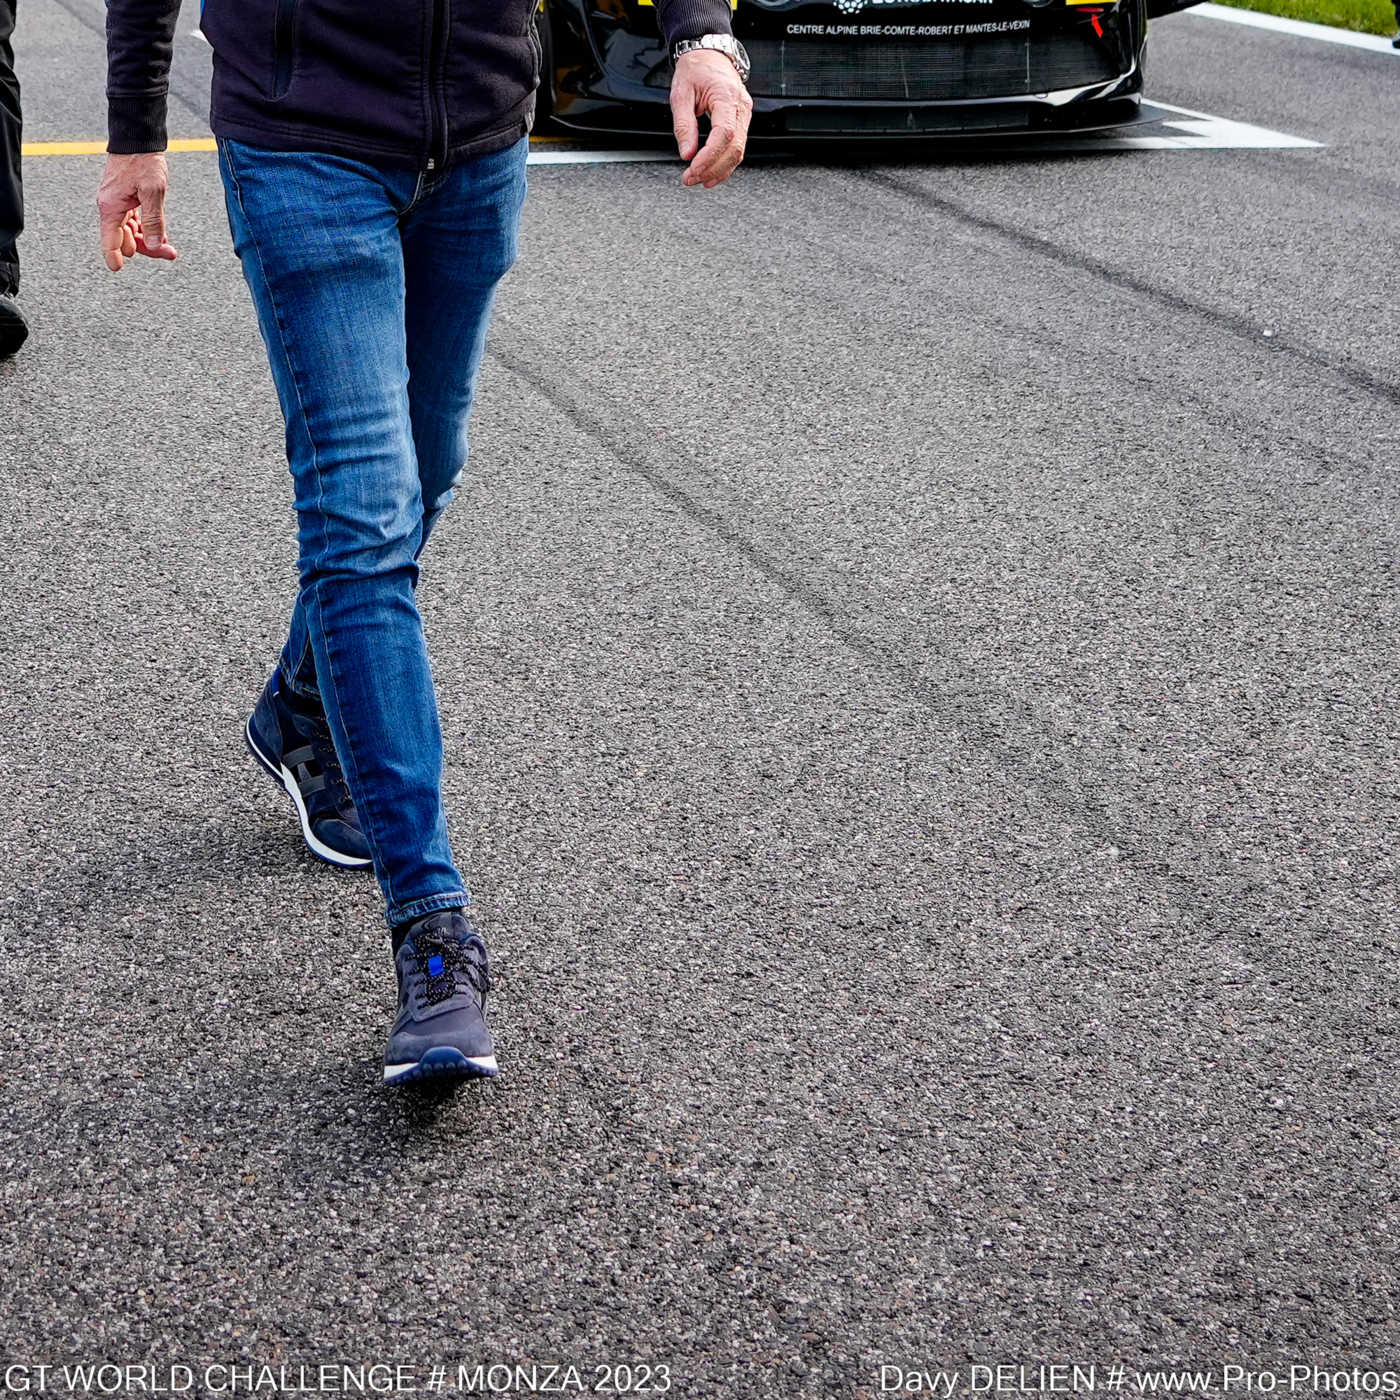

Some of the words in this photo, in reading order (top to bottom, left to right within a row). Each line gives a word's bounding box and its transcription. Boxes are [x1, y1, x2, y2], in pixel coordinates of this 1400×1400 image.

[787, 24, 824, 34] CENTRE
[825, 25, 859, 35] ALPINE
[860, 25, 952, 36] BRIE-COMTE-ROBERT
[954, 25, 965, 34] ET
